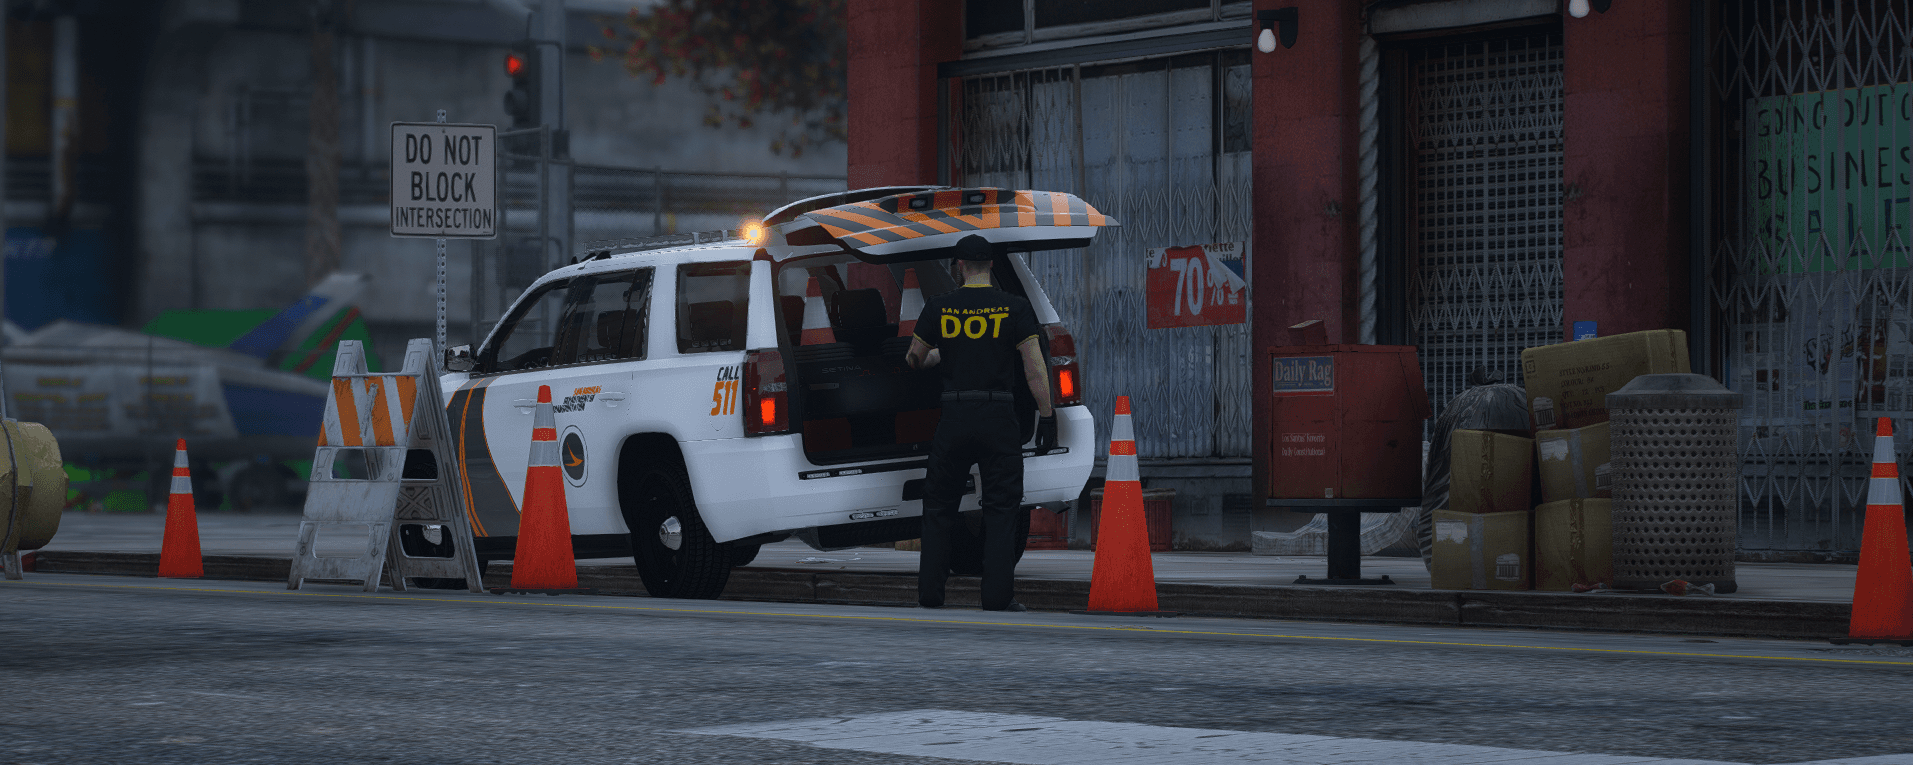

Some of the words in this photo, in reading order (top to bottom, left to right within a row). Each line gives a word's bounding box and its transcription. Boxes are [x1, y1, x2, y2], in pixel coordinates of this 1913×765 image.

[406, 133, 432, 164] DO
[444, 134, 483, 165] NOT
[411, 171, 477, 202] BLOCK
[396, 206, 492, 229] INTERSECTION
[941, 307, 960, 315] SAN
[962, 306, 1010, 315] ANDREAS
[940, 312, 1010, 339] DOT
[716, 365, 740, 381] CALL
[821, 364, 862, 374] SETINA
[1275, 359, 1307, 387] Daily
[1309, 359, 1332, 387] Rag
[710, 379, 740, 416] 511
